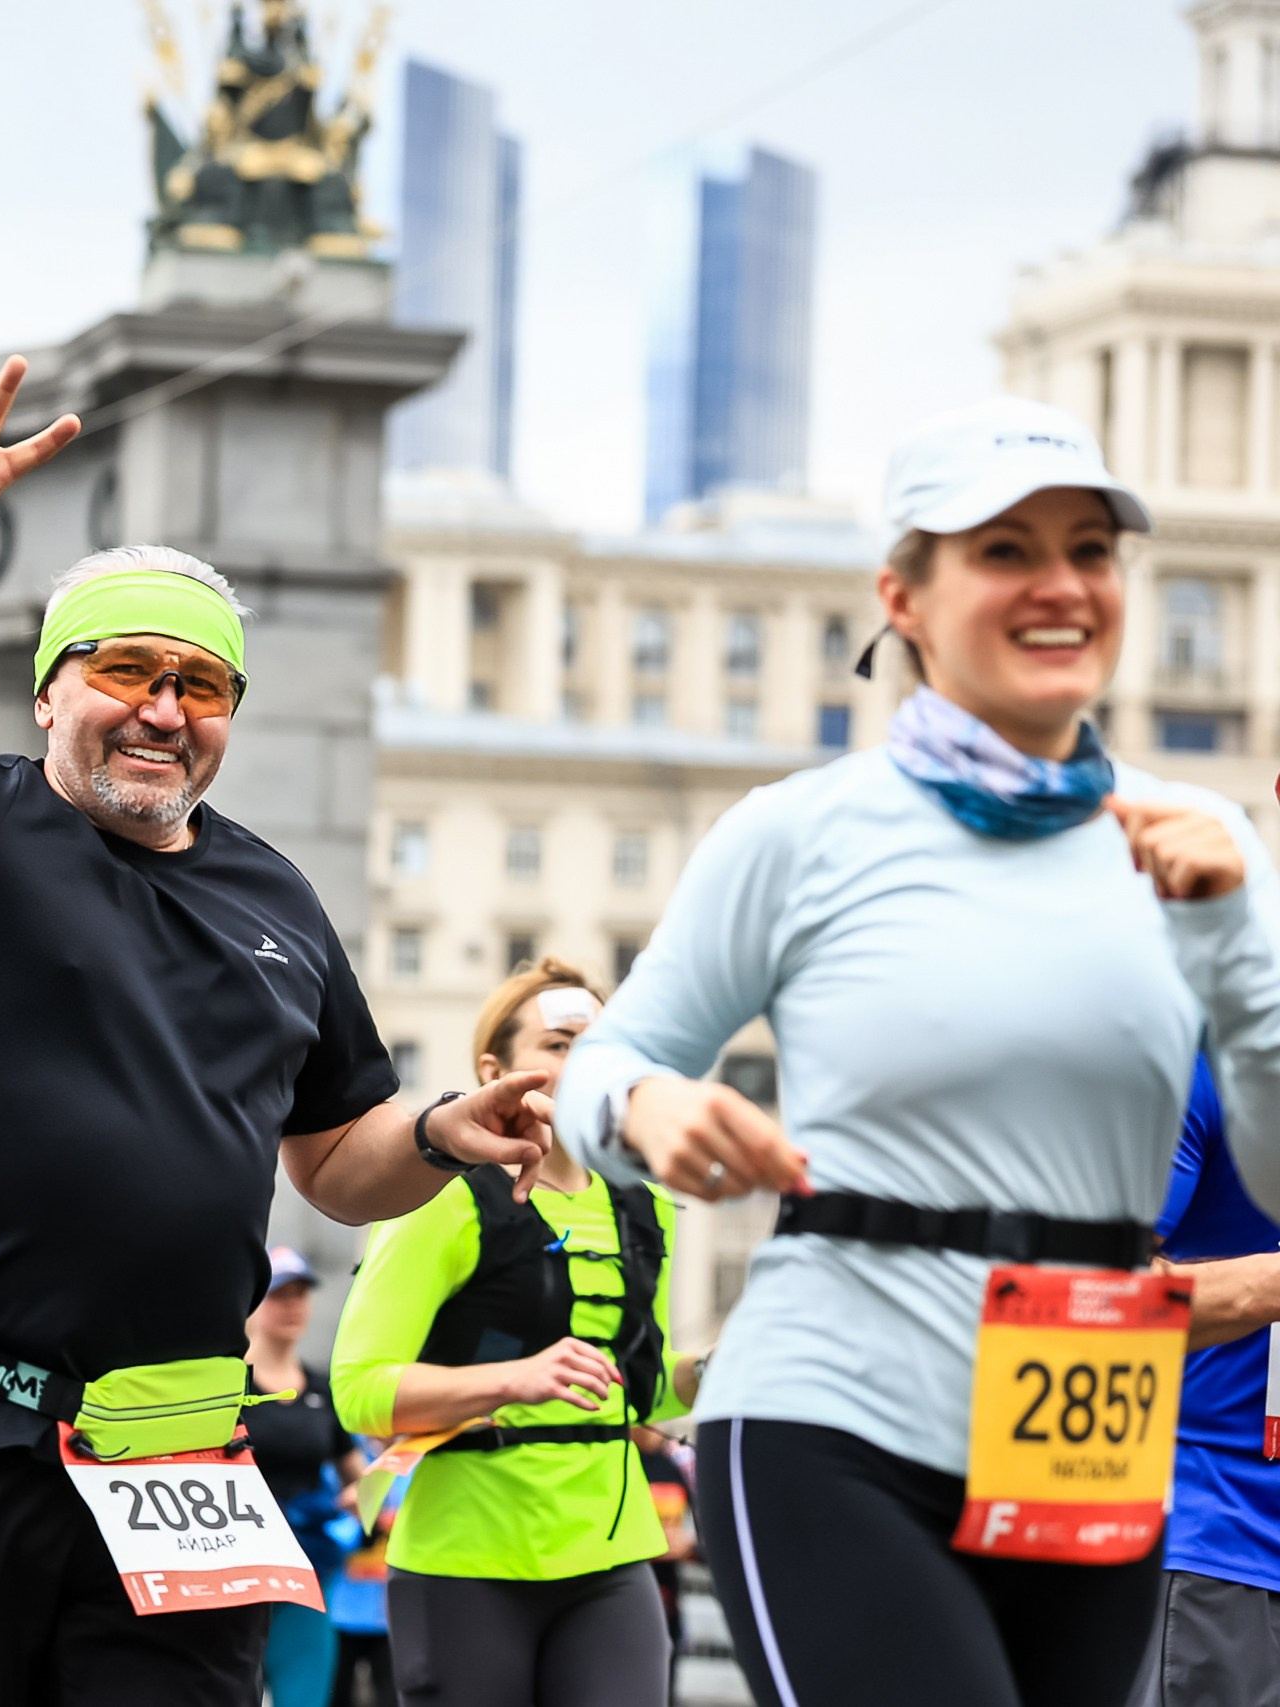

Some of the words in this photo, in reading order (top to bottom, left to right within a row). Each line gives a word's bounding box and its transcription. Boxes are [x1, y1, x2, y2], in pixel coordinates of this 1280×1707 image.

[1011, 1360, 1158, 1444] 2859
[109, 1479, 265, 1531] 2084
[981, 1502, 1019, 1549] F
[177, 1534, 237, 1553] АЙДАР
[142, 1572, 169, 1607] F
